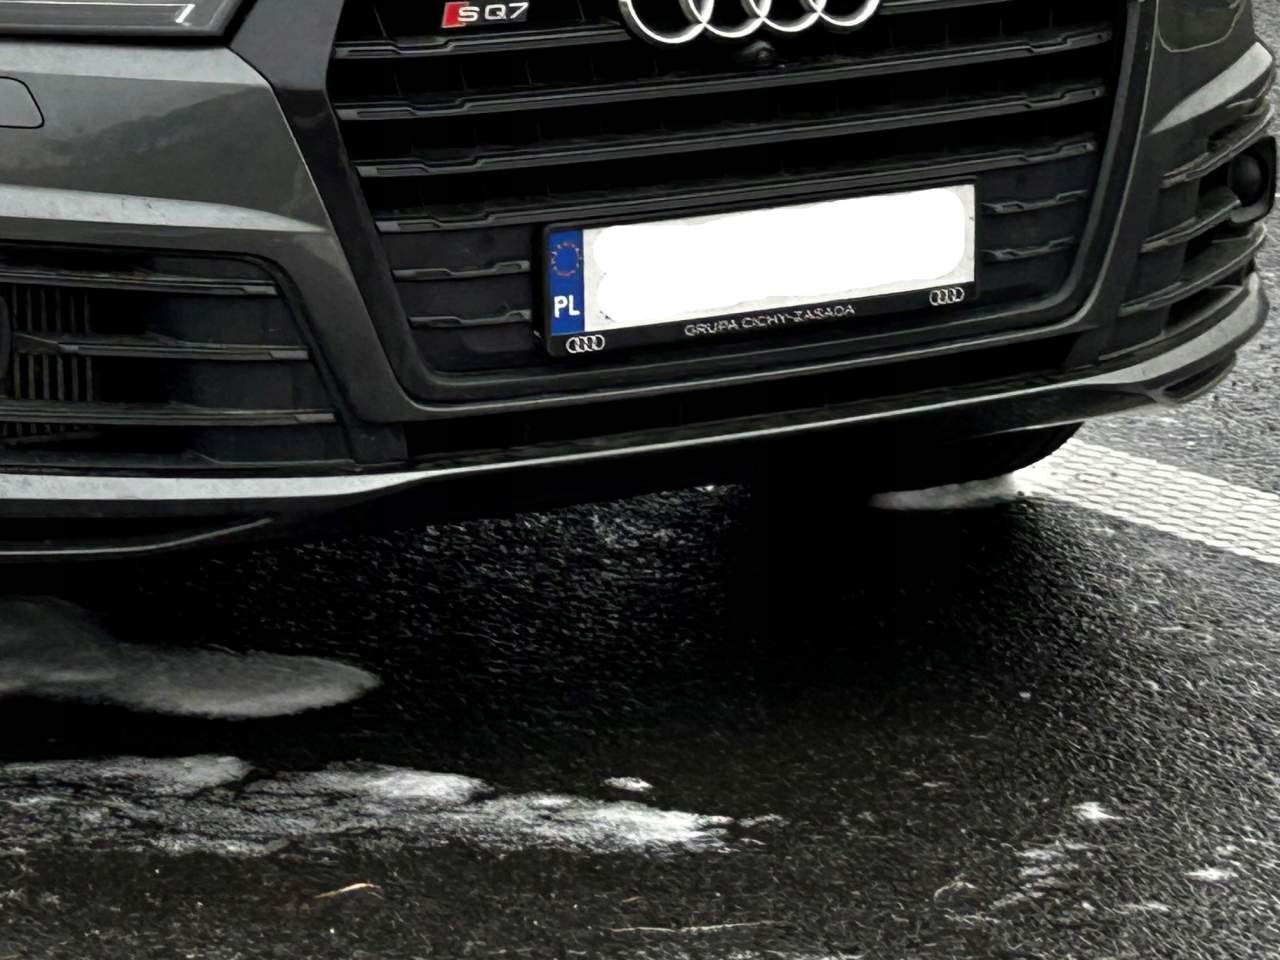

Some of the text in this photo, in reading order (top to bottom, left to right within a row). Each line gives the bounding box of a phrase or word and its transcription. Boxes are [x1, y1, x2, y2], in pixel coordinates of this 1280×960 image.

[457, 1, 529, 22] SQ7
[554, 294, 581, 318] PL
[684, 319, 739, 336] GRUPA
